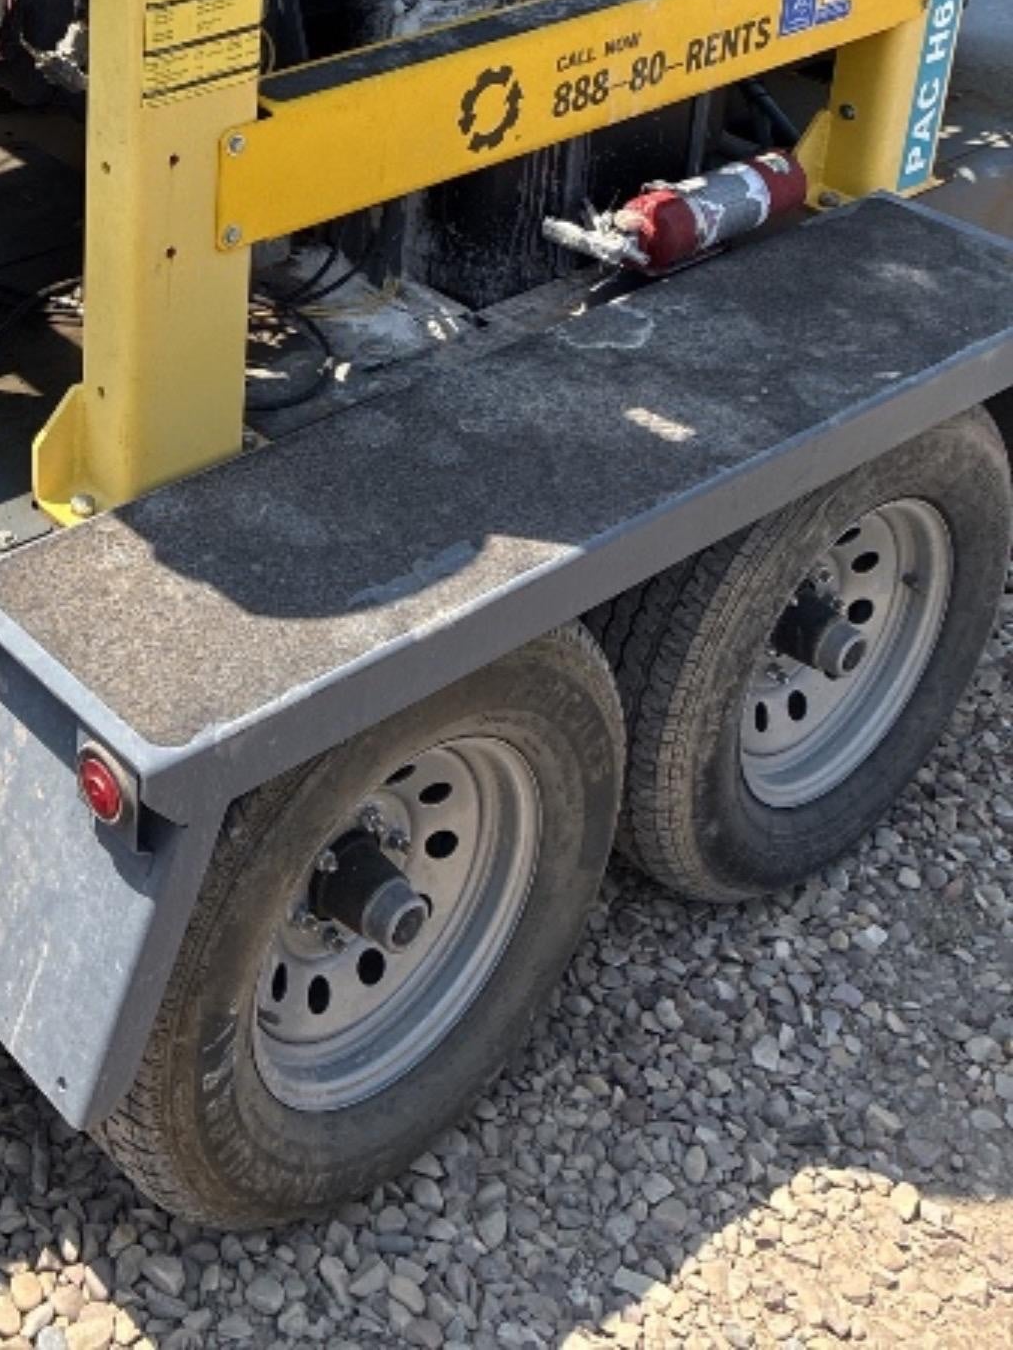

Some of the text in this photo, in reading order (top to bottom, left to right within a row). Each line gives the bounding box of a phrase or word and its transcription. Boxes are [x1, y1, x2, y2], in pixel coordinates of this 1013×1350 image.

[556, 32, 642, 73] CALL NOW
[905, 77, 940, 175] PAC
